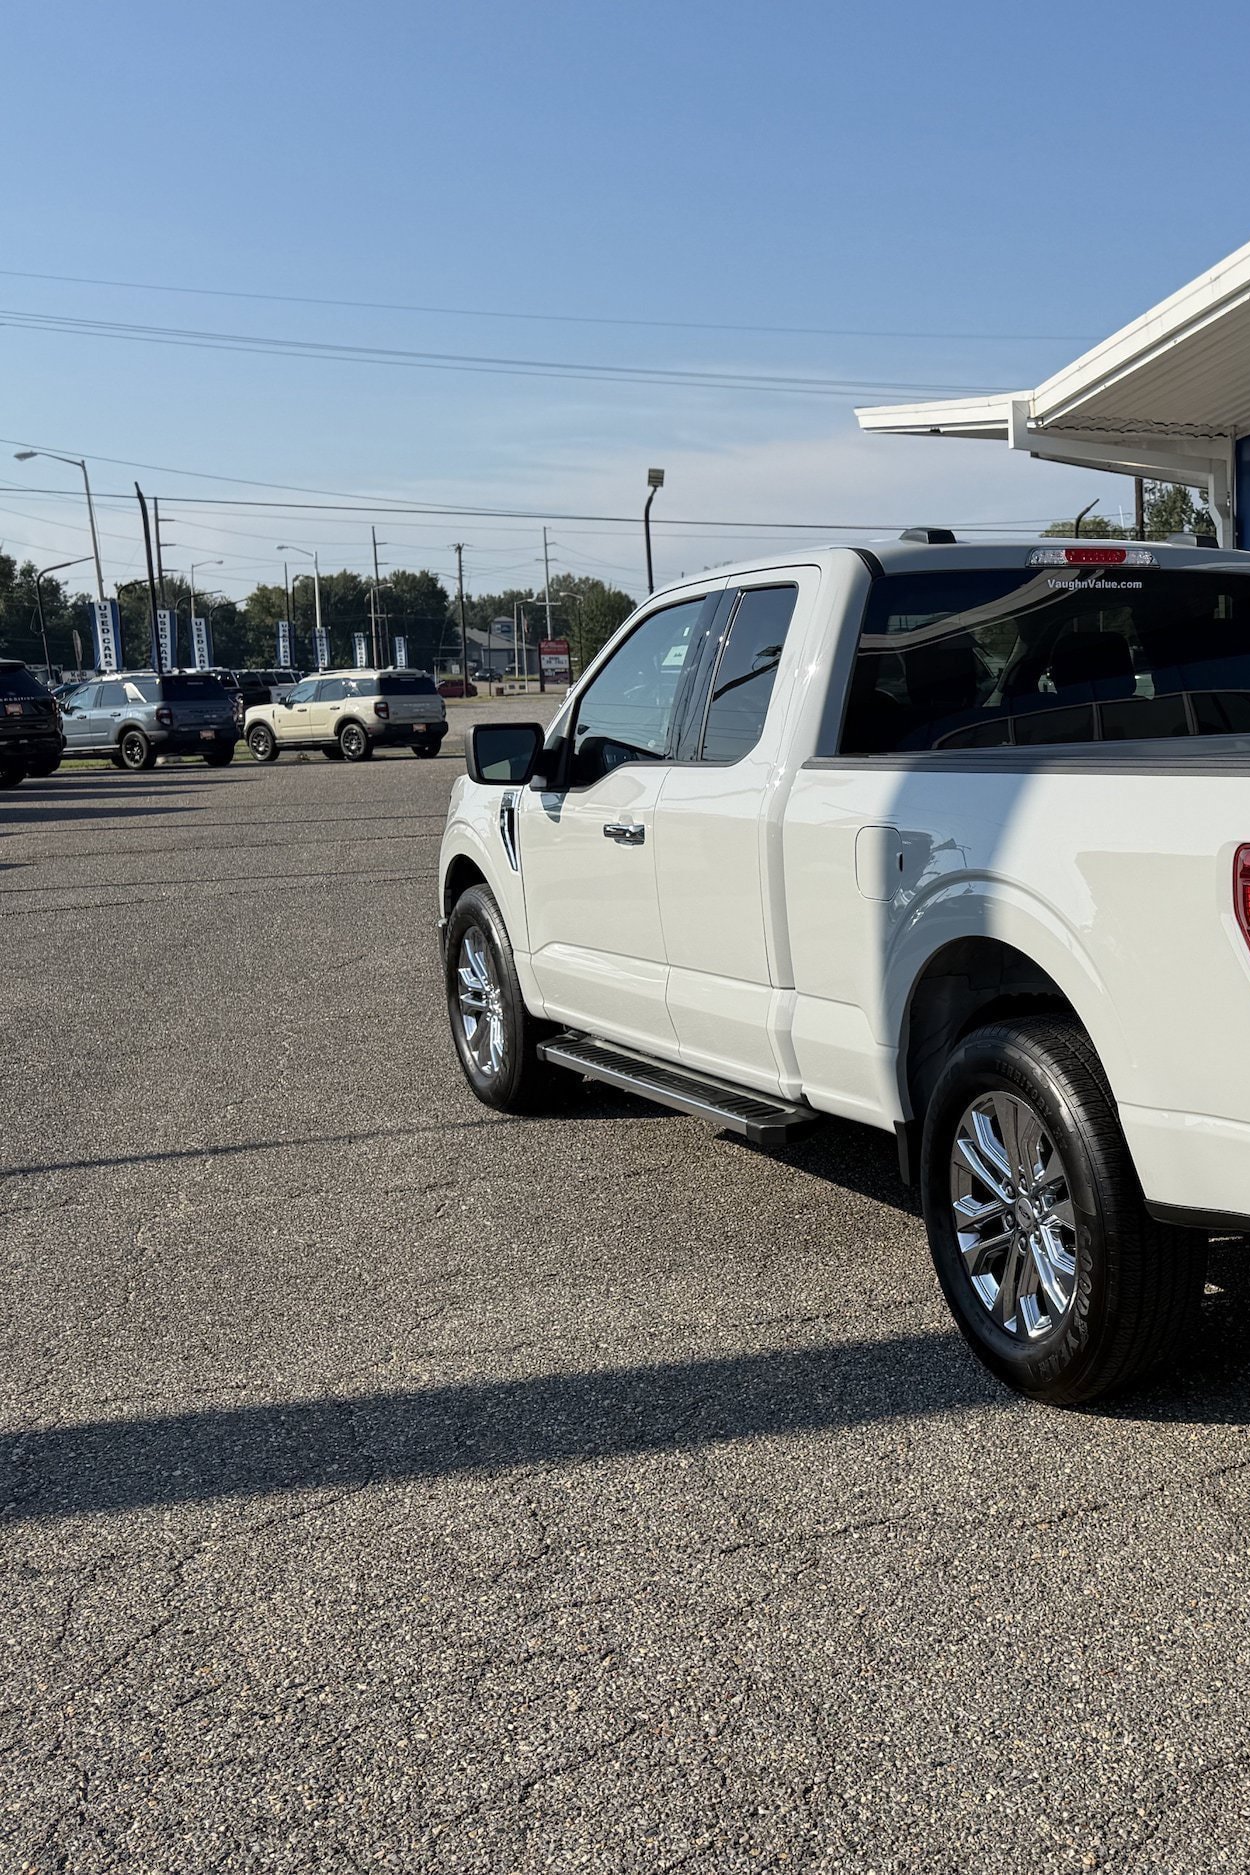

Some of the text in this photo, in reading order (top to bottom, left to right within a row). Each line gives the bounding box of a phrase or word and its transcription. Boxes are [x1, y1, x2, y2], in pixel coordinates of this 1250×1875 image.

[1047, 579, 1143, 590] VaughnValue.com
[98, 604, 113, 667] USED CARS
[158, 613, 168, 669] USED CARS
[194, 621, 204, 645] USED
